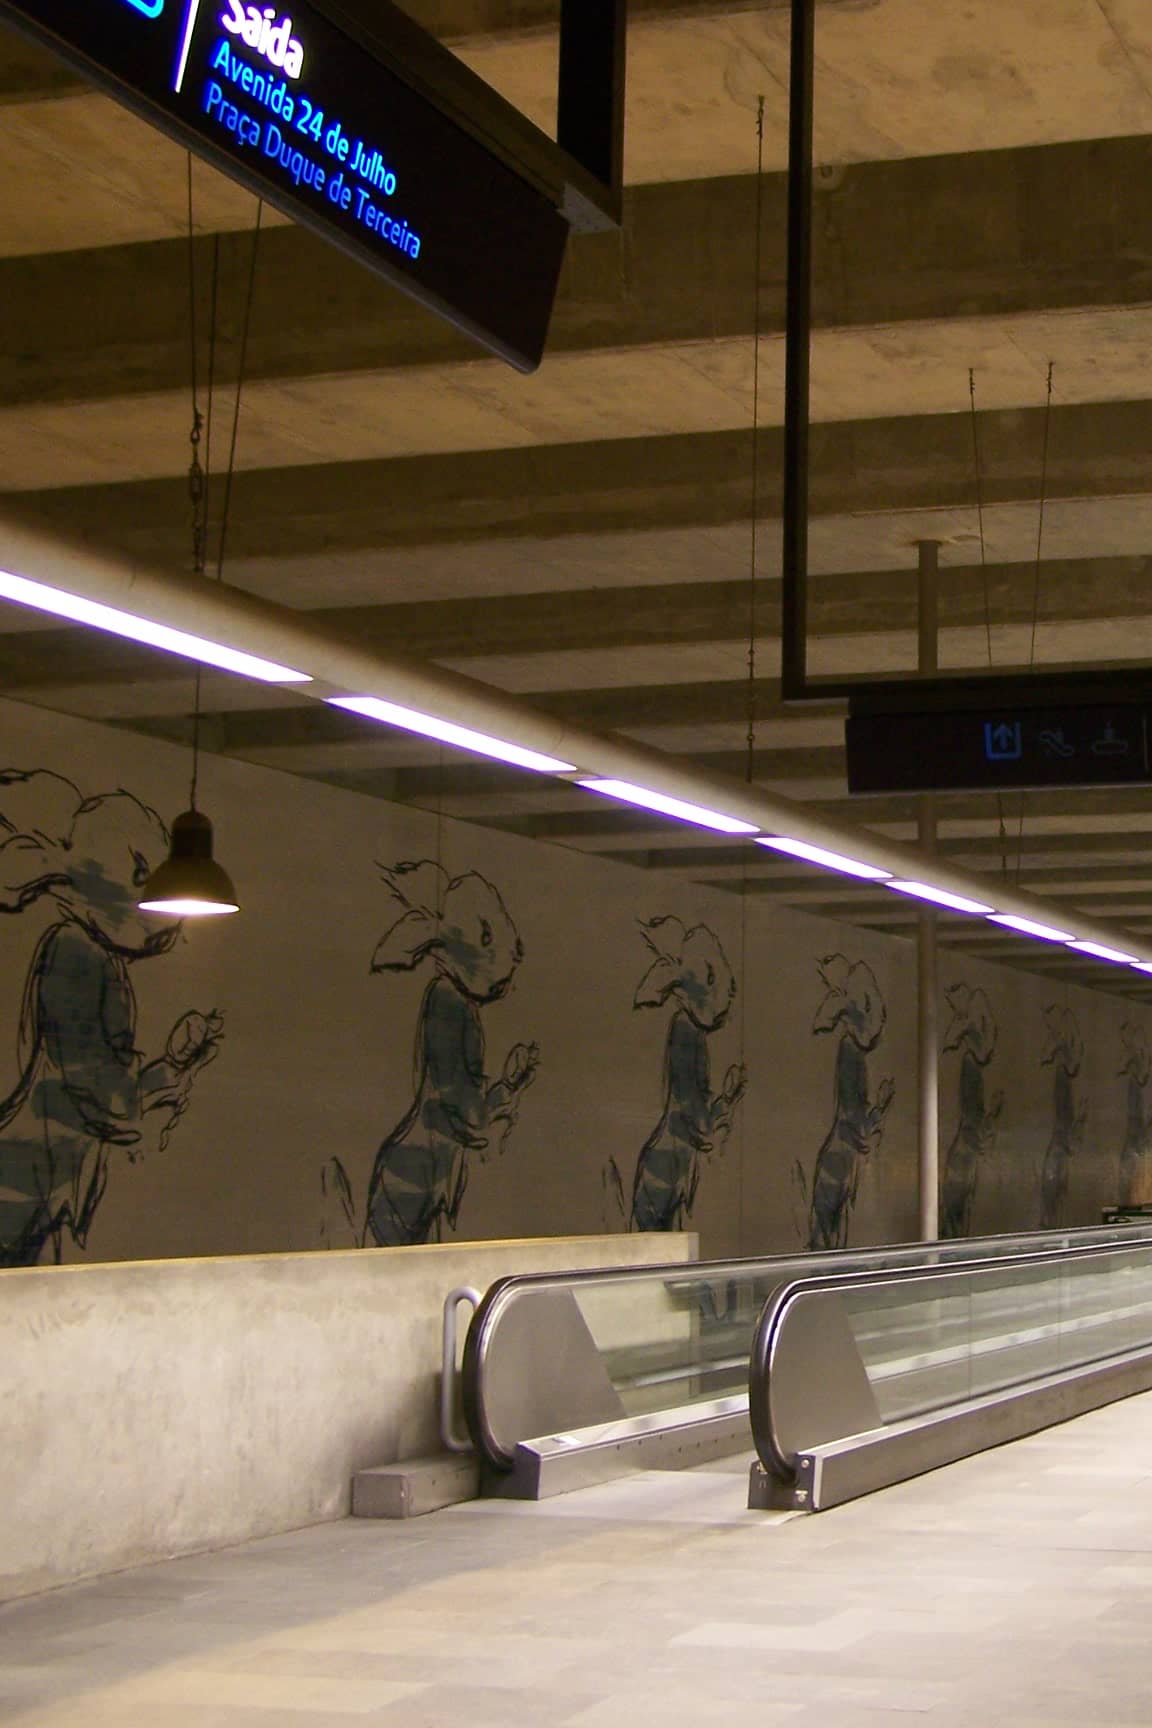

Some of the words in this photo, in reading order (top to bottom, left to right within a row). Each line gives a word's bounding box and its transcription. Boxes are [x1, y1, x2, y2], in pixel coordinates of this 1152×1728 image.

[204, 82, 262, 147] Praça
[263, 123, 327, 192] Duque
[328, 173, 352, 210] de
[355, 186, 422, 260] Terceira
[212, 40, 295, 122] Avenida
[296, 98, 325, 143] 24
[326, 123, 350, 162] de
[350, 141, 397, 196] Julho
